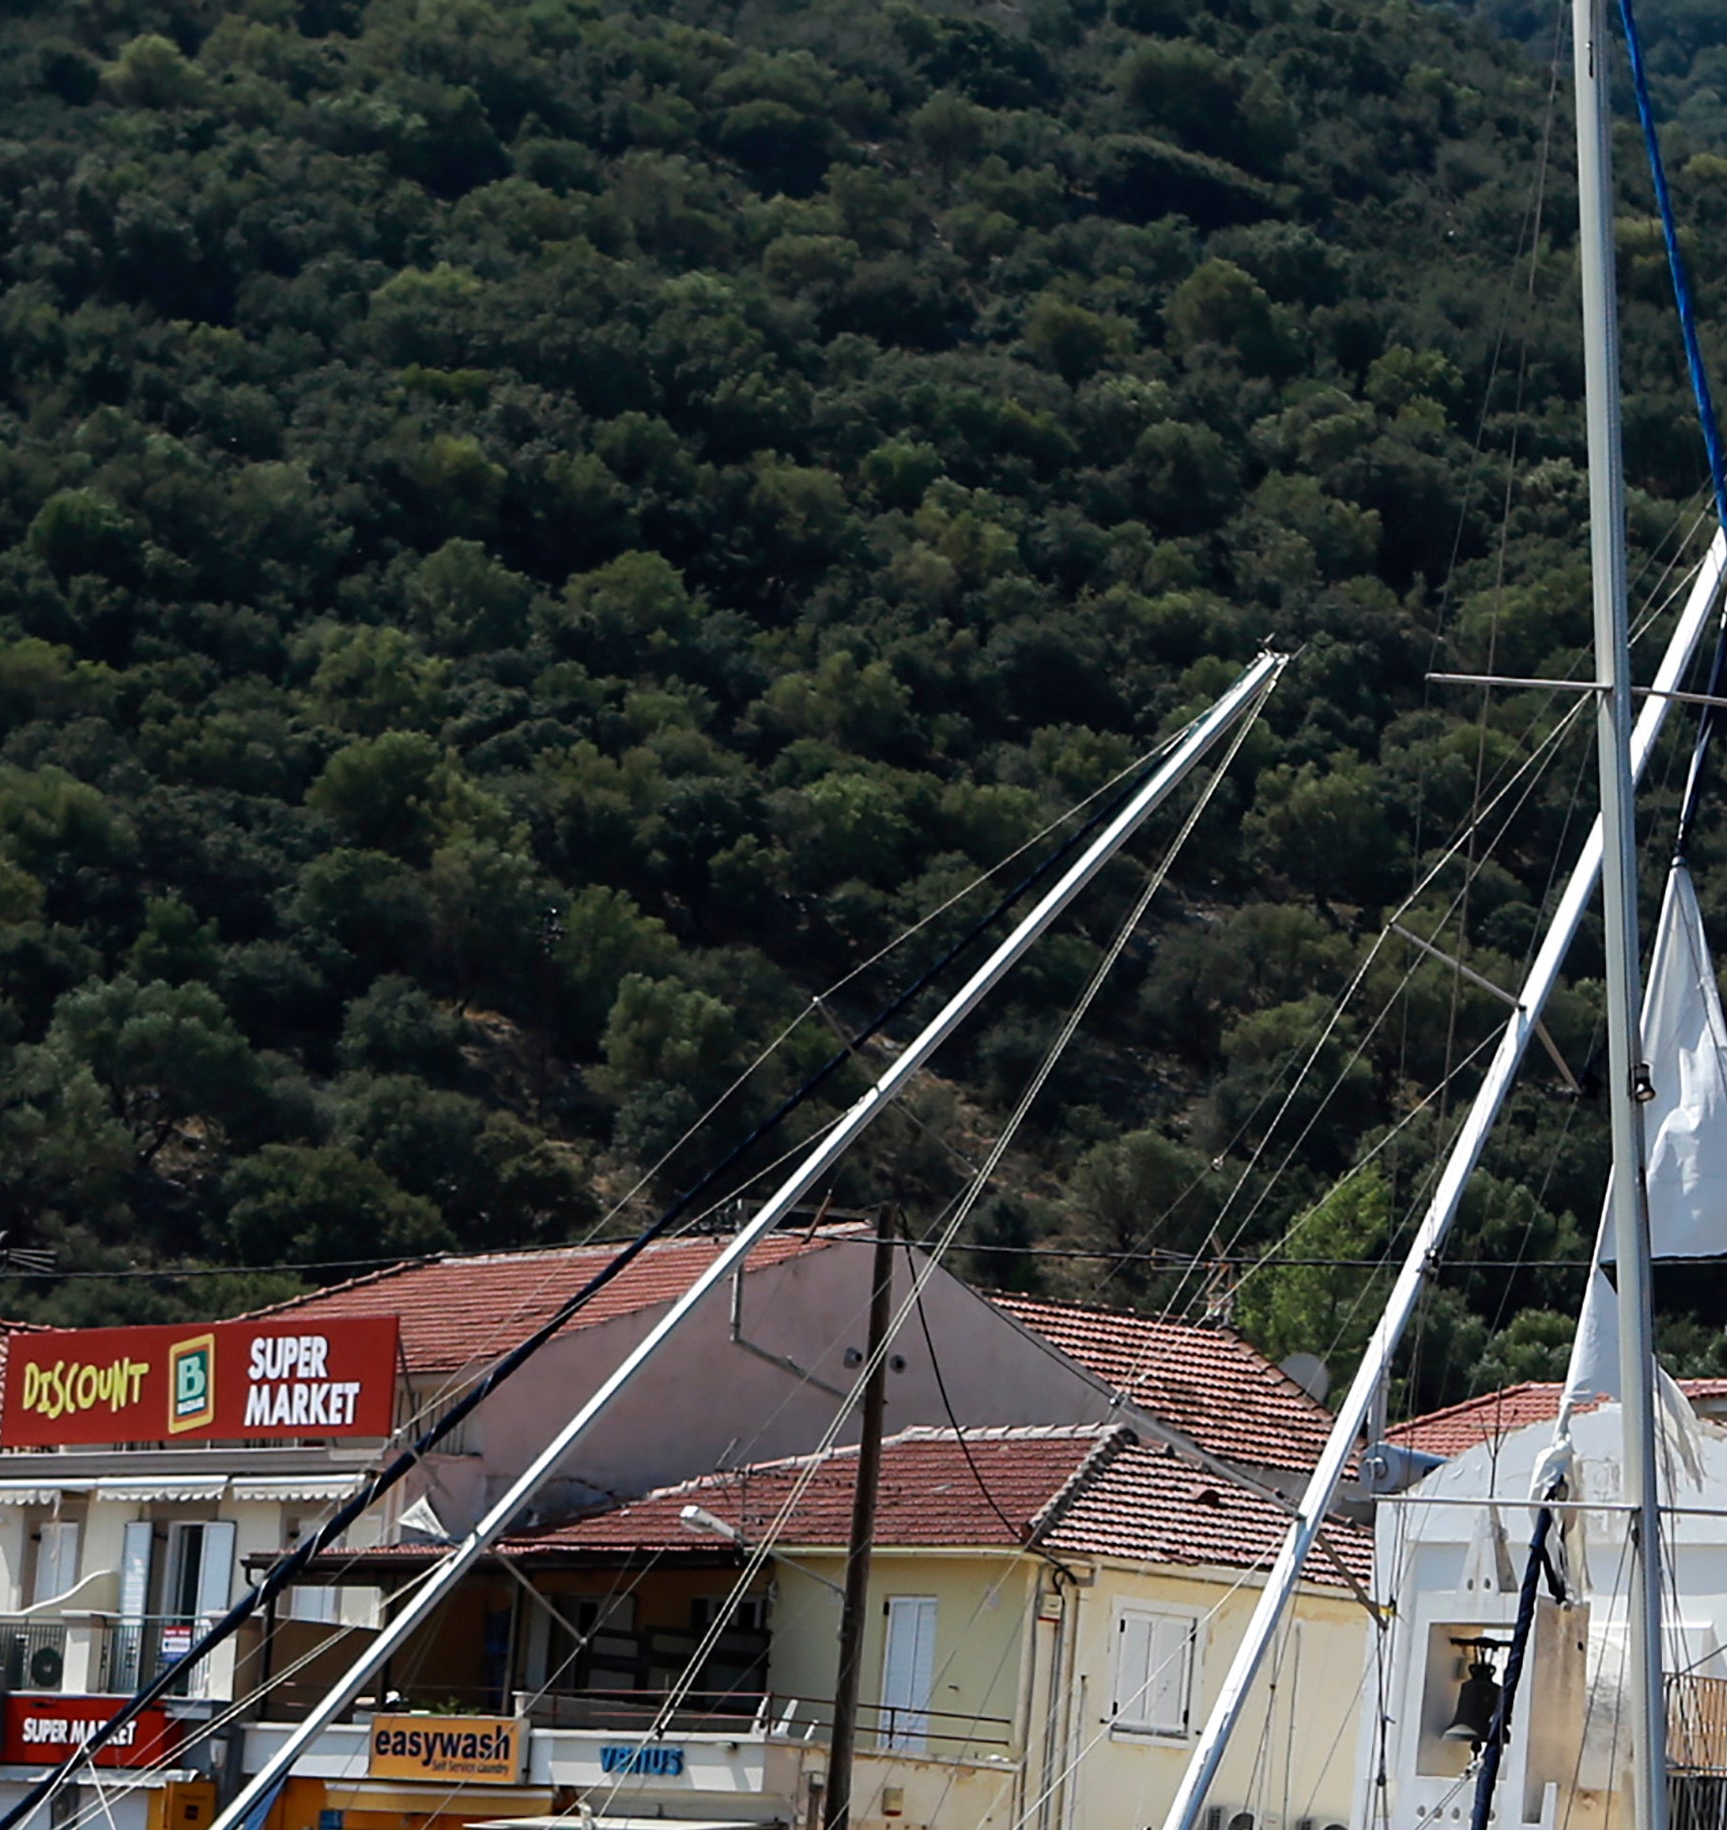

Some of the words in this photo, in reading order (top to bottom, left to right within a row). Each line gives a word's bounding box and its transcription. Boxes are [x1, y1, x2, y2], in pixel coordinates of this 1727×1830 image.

[178, 1356, 206, 1400] B
[248, 1336, 328, 1380] SUPER
[22, 1357, 149, 1419] DISCOUNT
[244, 1382, 360, 1427] MARKET
[22, 1717, 67, 1743] SUPER
[375, 1725, 510, 1766] easywash
